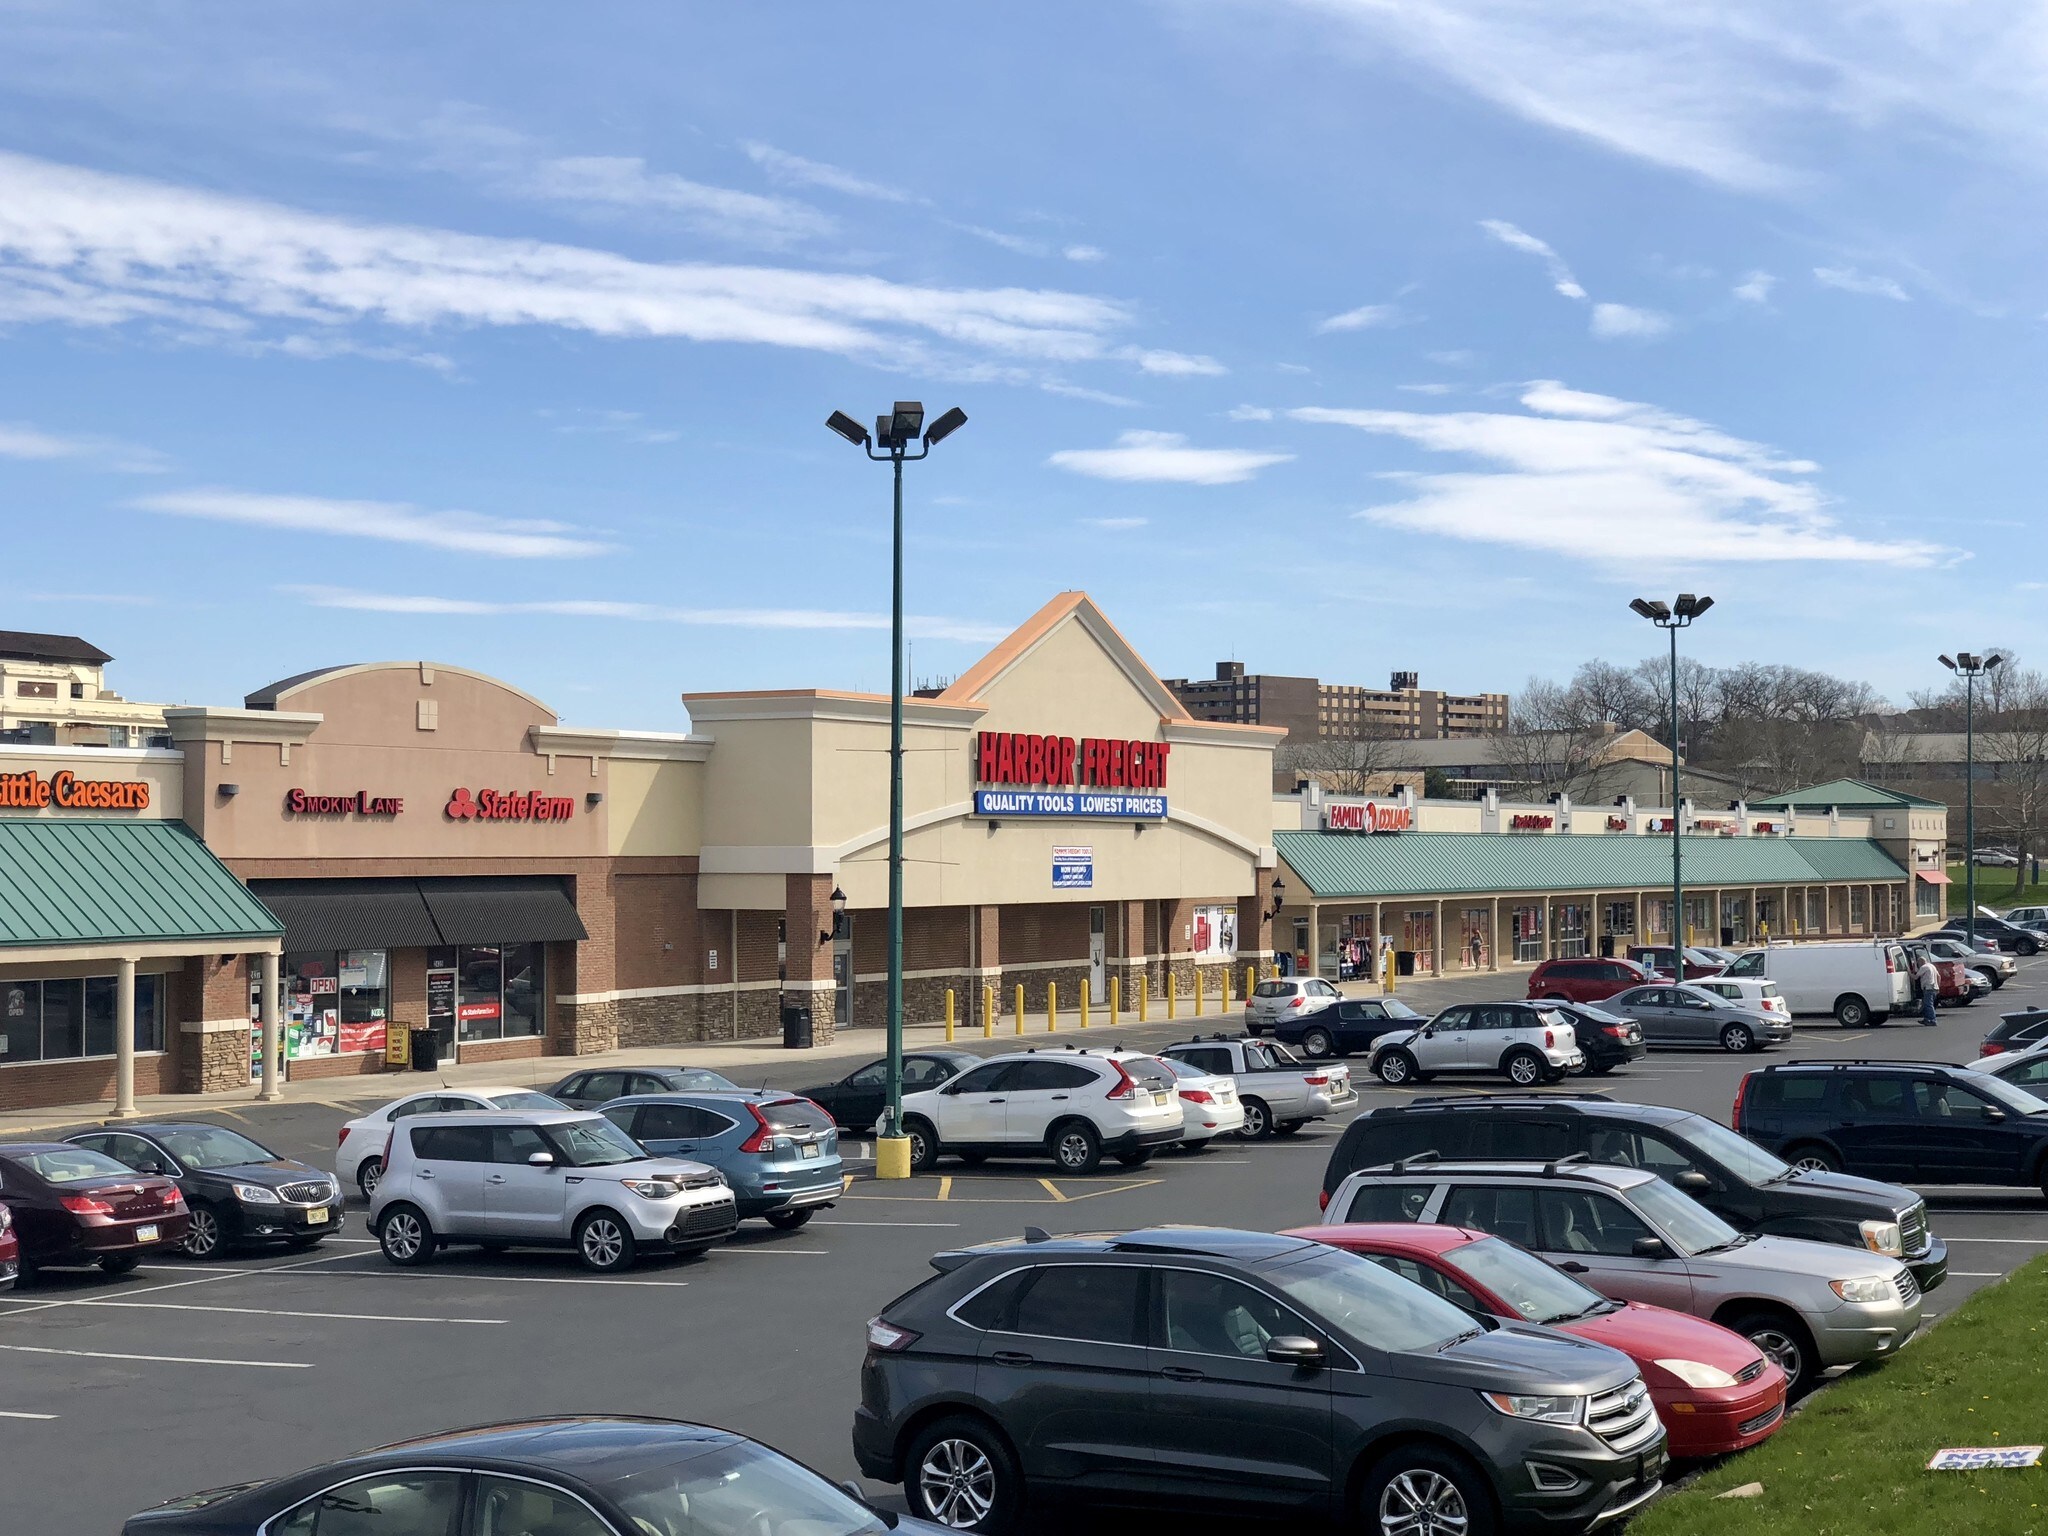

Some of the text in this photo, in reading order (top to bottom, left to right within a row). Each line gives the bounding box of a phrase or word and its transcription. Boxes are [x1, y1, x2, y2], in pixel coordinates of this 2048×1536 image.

[977, 731, 1170, 789] HARBOR FREIGHT
[0, 770, 149, 809] ittle Caesars
[358, 790, 404, 814] LANE
[983, 794, 1163, 814] QUALITY TOOLS LOWEST PRICES
[1330, 805, 1364, 828] FAMILY
[312, 979, 336, 993] OPEN
[8, 1008, 24, 1017] OPEN
[1946, 1451, 2032, 1461] NOW
